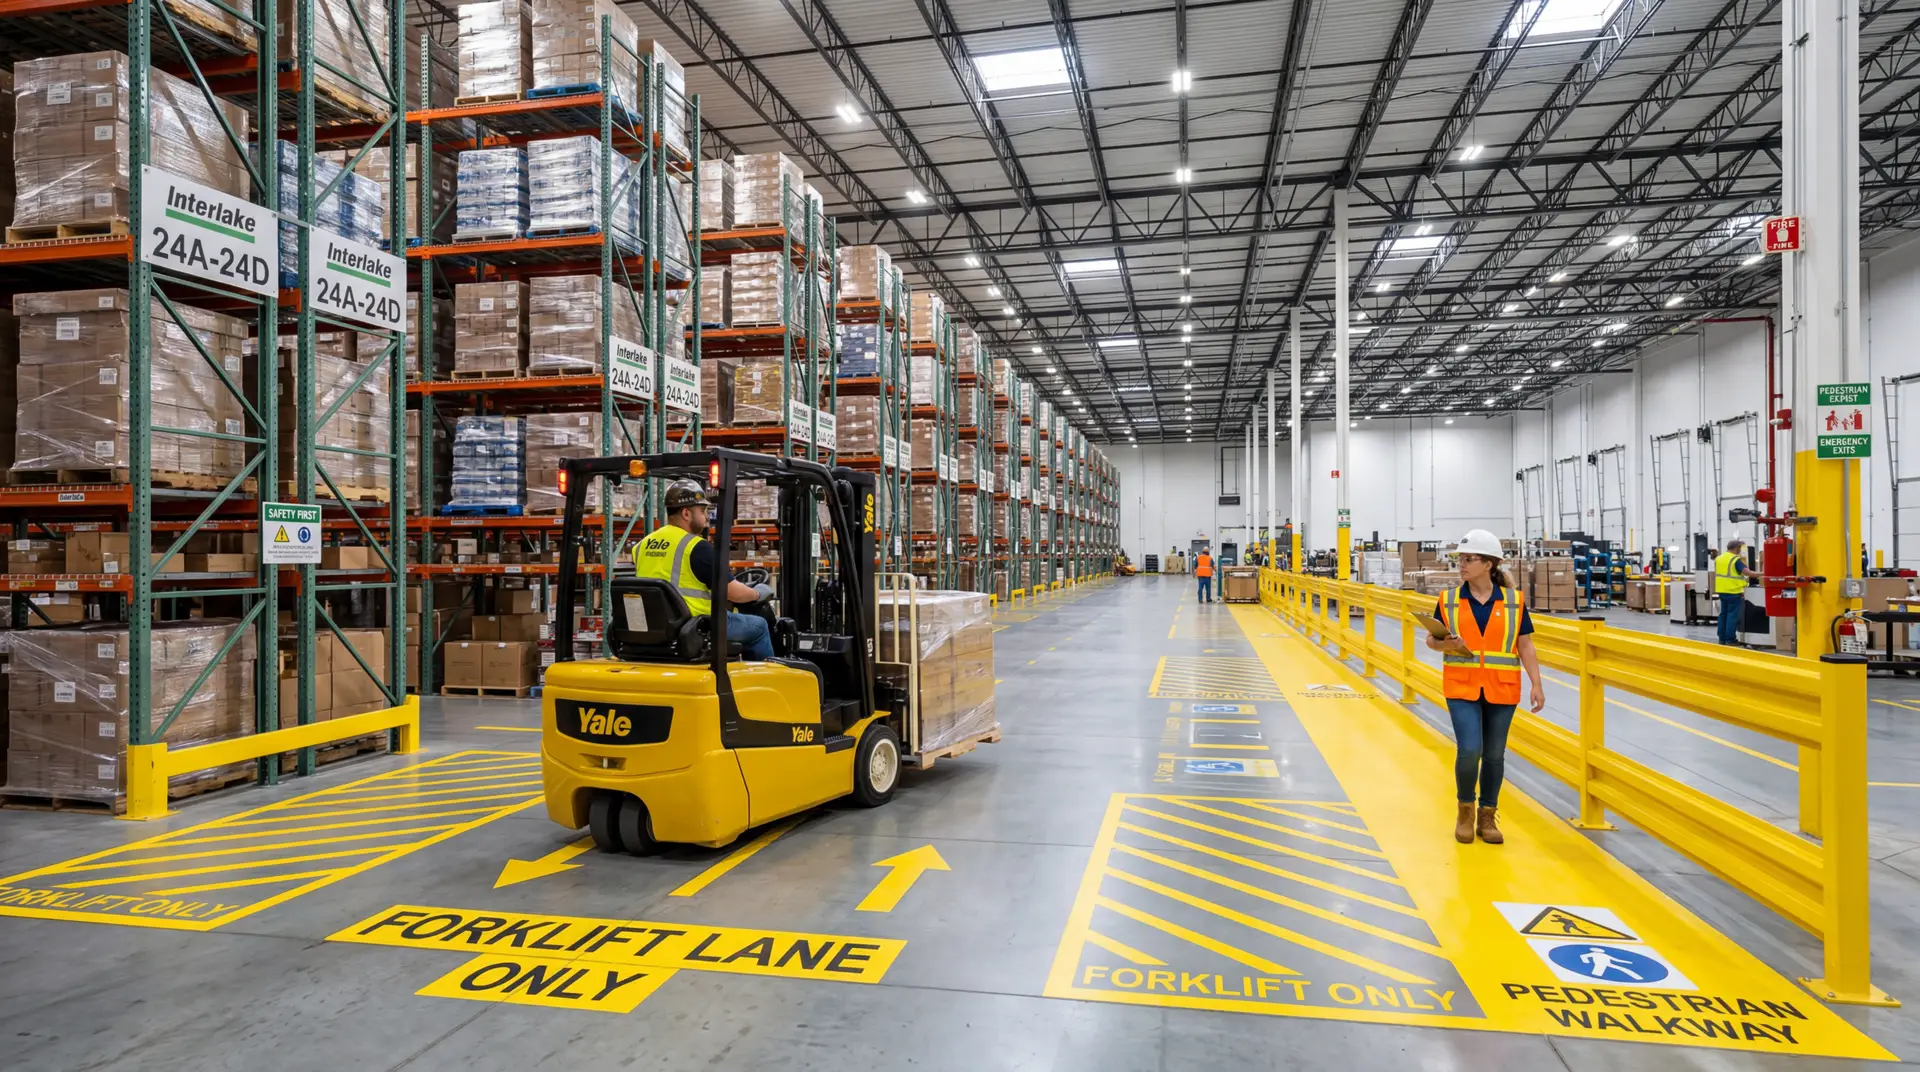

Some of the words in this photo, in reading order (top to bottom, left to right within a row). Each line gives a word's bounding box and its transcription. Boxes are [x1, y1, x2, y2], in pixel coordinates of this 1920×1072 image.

[167, 185, 256, 233] Interlake
[1770, 219, 1796, 230] FIRE
[152, 226, 270, 286] 24A-24D
[327, 242, 392, 279] Interlake
[316, 277, 401, 324] 24A-24D
[616, 344, 648, 365] Interlake
[611, 367, 652, 394] 24A-24D
[1819, 385, 1868, 395] PEDESTRIAN
[666, 384, 700, 409] 24A-24D
[1820, 437, 1868, 447] EMERGENCY
[1832, 446, 1856, 455] EXITS
[268, 508, 296, 519] SAFETY
[297, 509, 317, 520] FIRST
[863, 493, 874, 534] Yale
[644, 538, 671, 551] Yale
[578, 707, 633, 737] Yale
[791, 725, 815, 743] Yale
[129, 899, 240, 918] ONLY
[357, 910, 688, 957] FORKLIFT
[683, 932, 883, 975] LANE
[459, 961, 649, 1002] ONLY
[1083, 965, 1311, 1001] FORKLIFT
[1327, 982, 1456, 1012] ONLY
[1500, 982, 1809, 1020] PEDESTRIAN
[1544, 1007, 1800, 1045] WALKWAY
